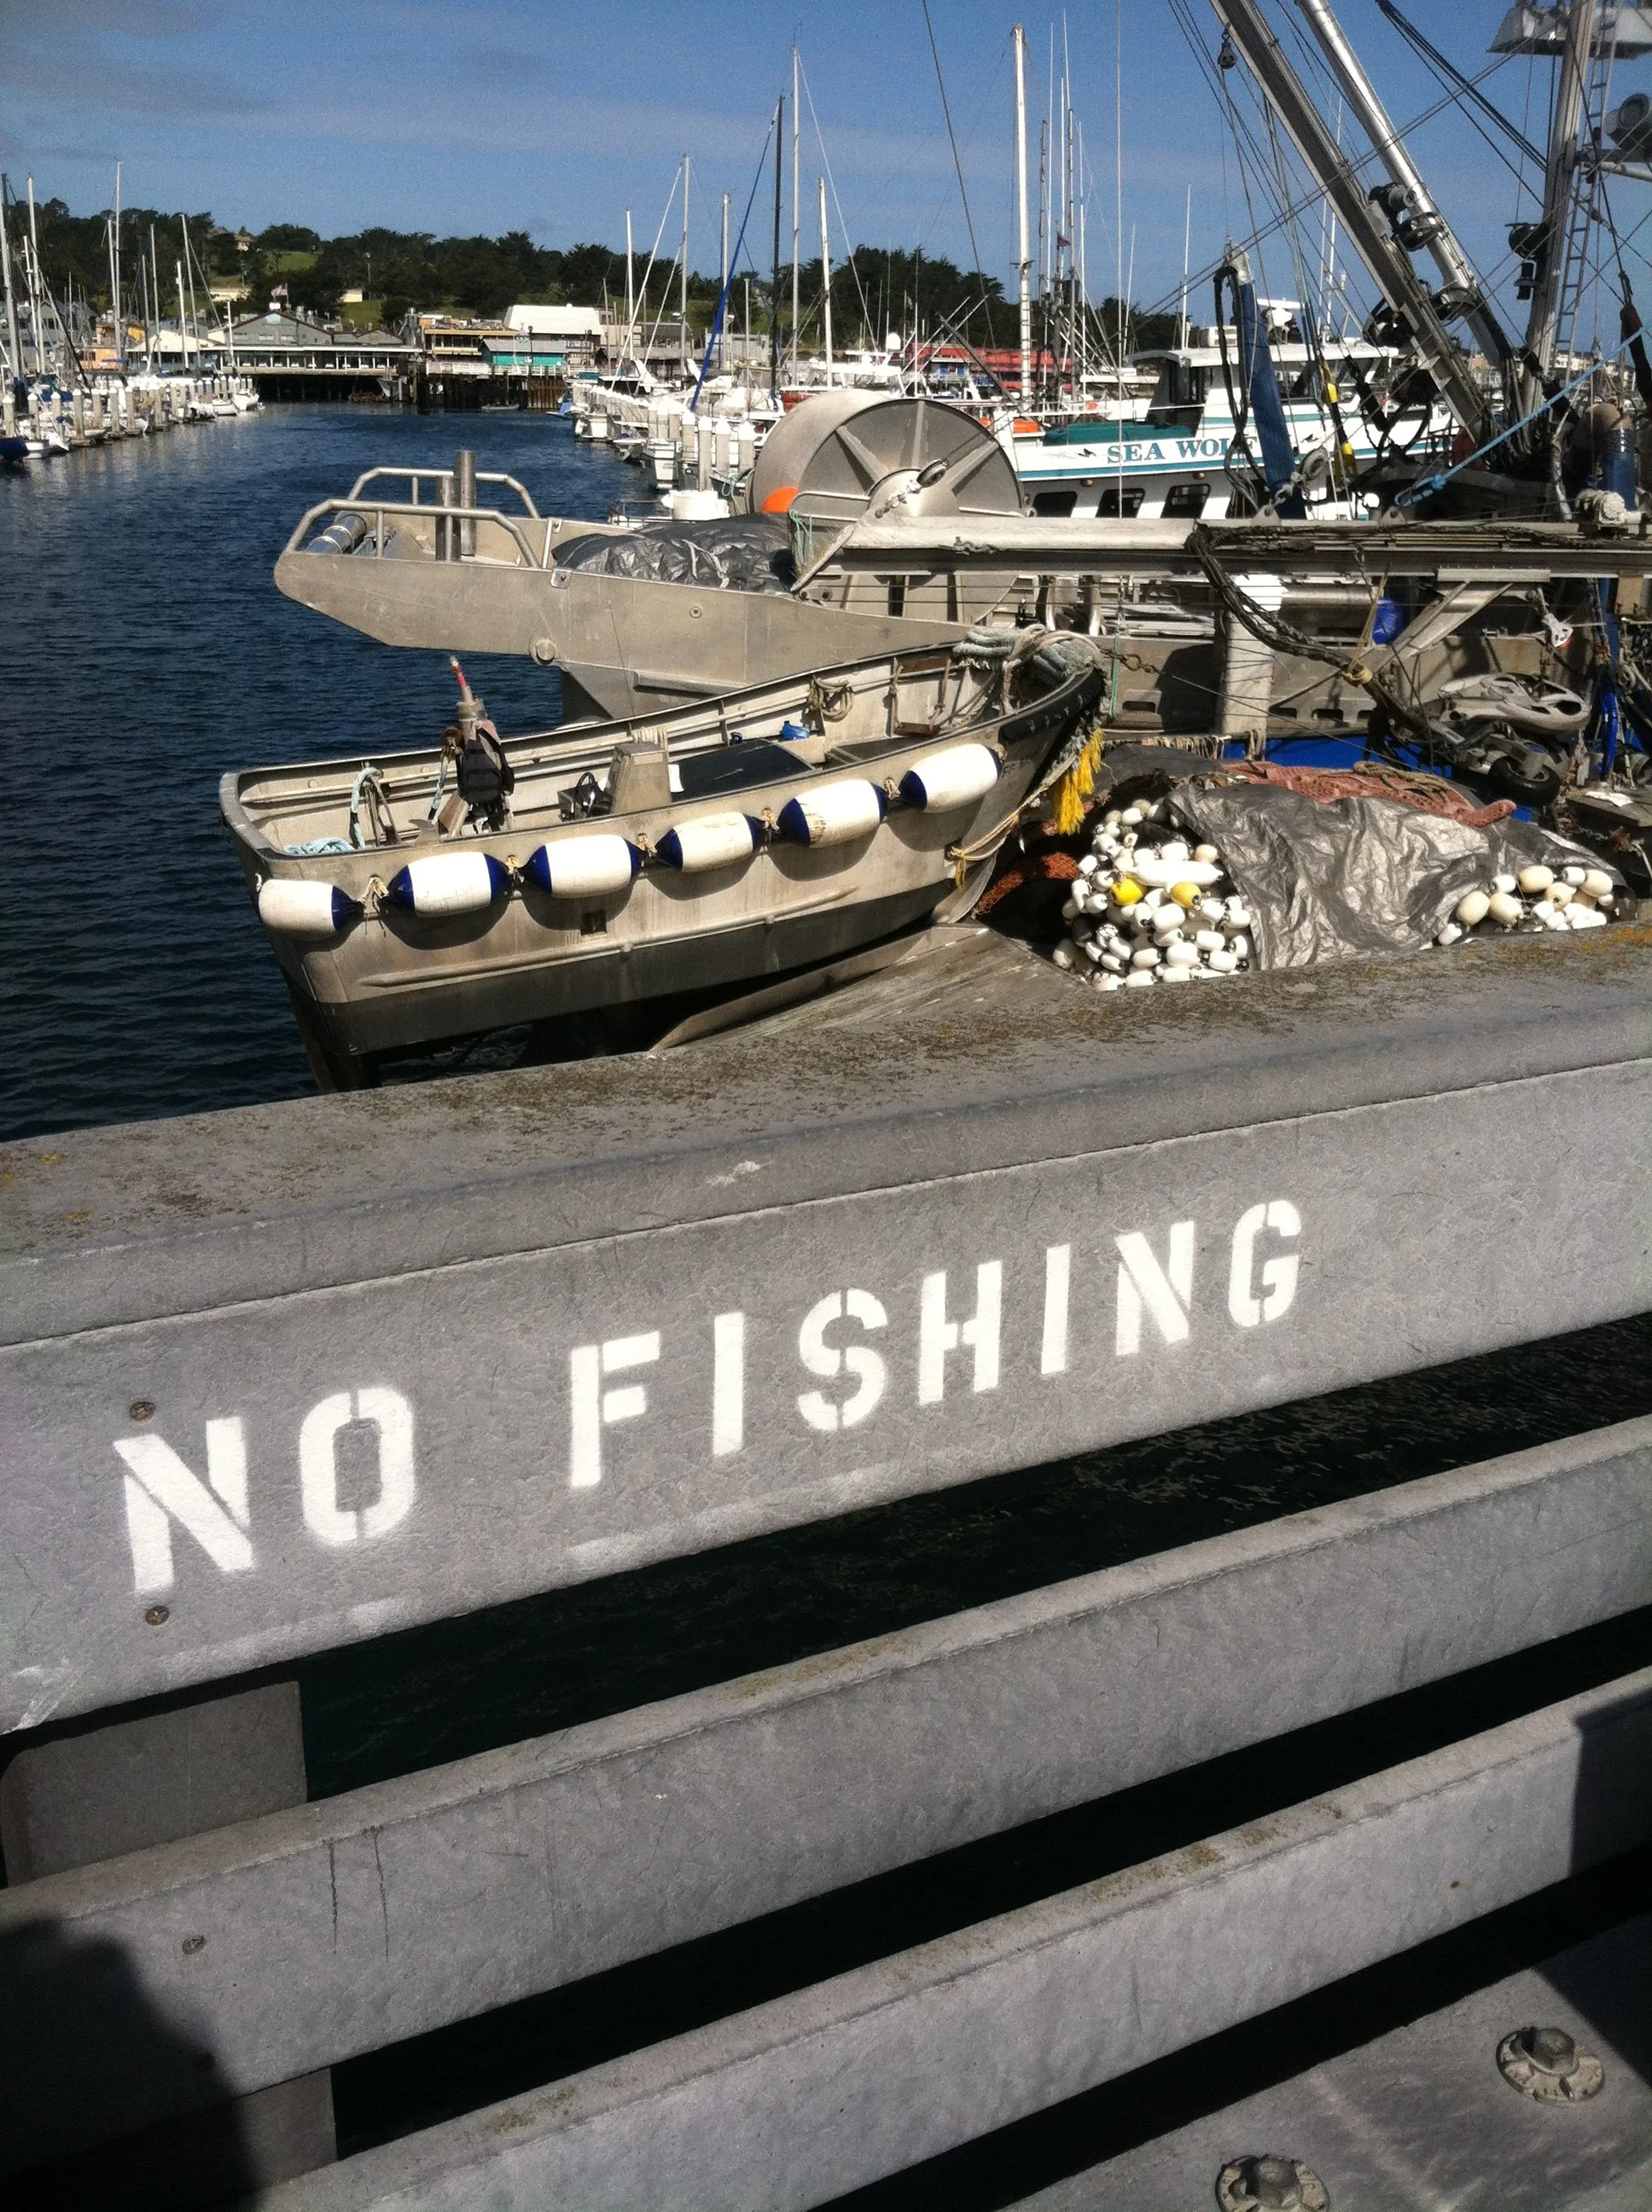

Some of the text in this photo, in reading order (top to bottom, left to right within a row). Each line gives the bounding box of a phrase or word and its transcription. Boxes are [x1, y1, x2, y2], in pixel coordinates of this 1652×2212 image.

[1107, 442, 1166, 464] SEA
[112, 1199, 1303, 1594] NO FISHING
